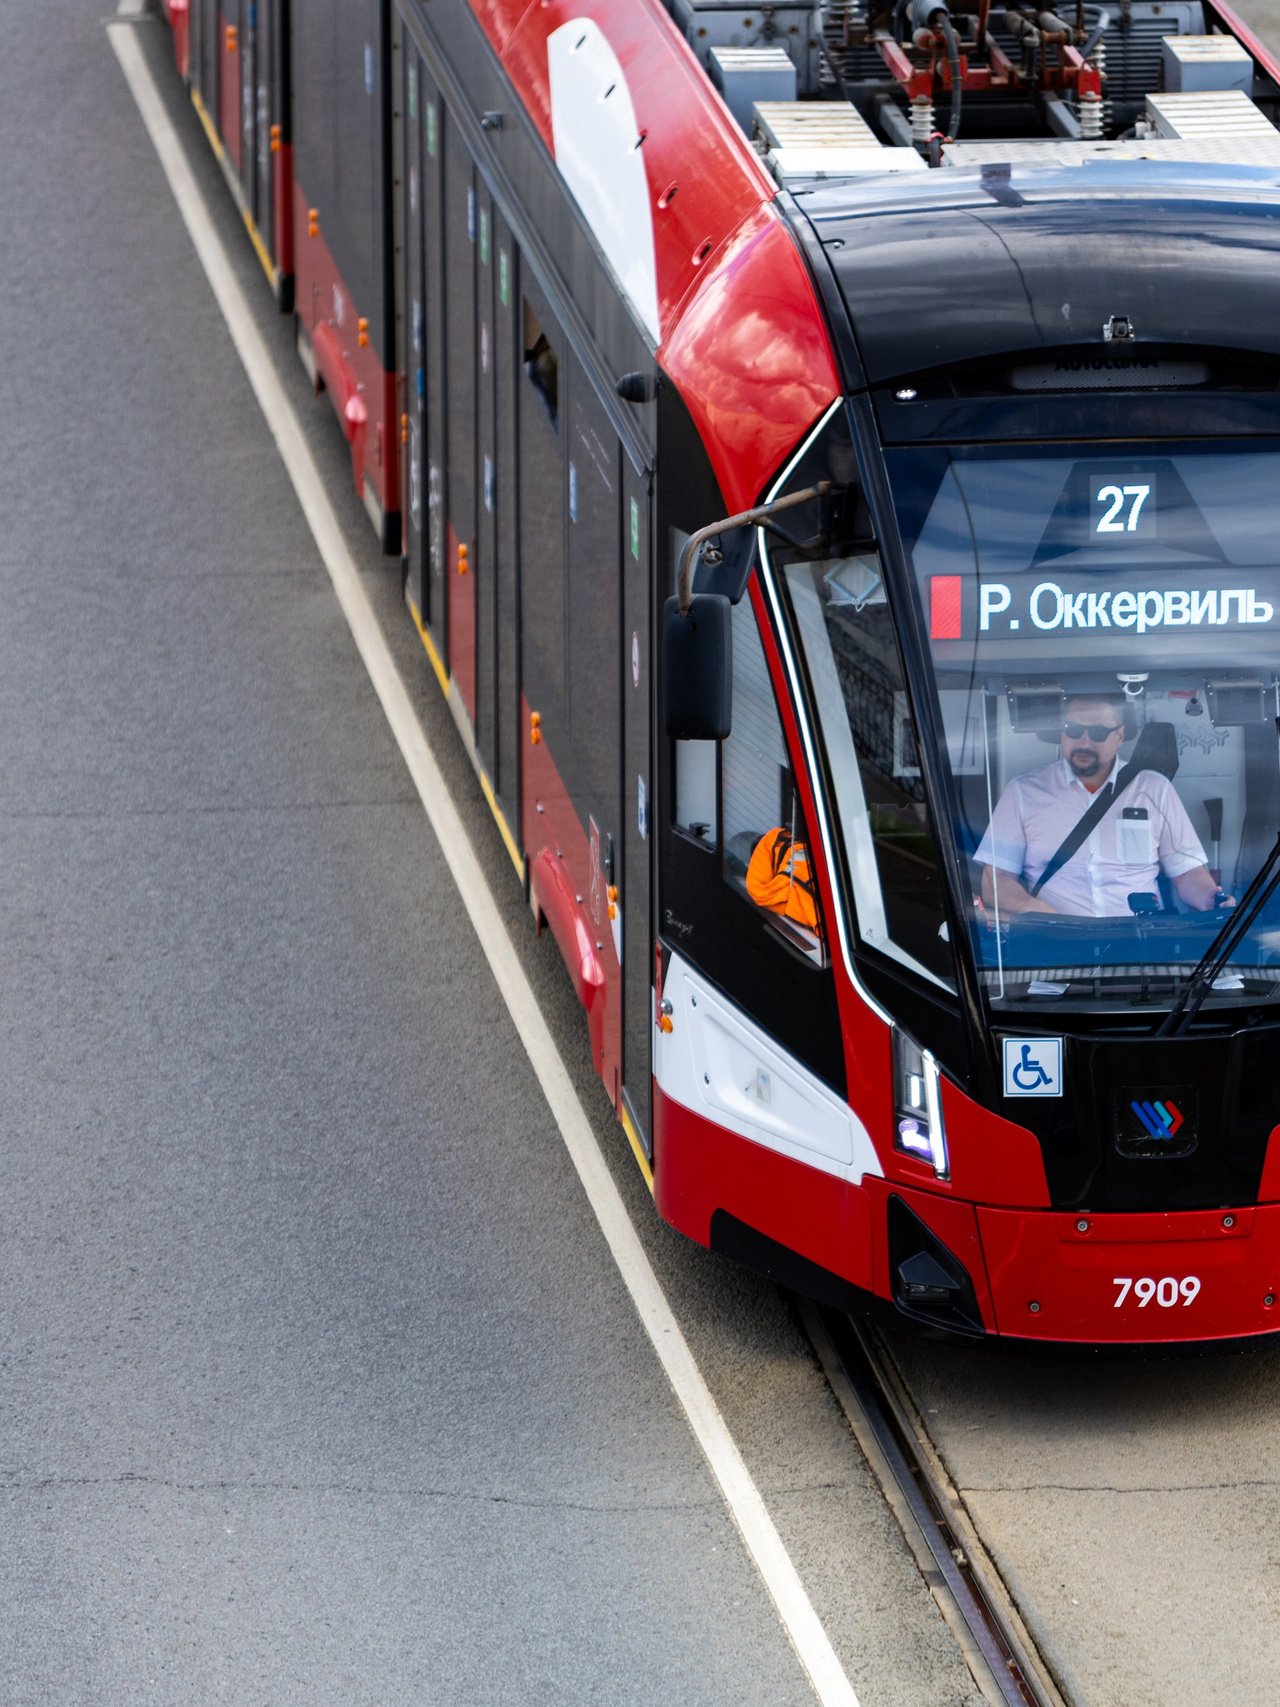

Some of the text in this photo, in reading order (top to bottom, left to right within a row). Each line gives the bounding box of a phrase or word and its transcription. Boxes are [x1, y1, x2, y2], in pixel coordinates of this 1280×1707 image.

[1096, 485, 1150, 533] 27
[980, 582, 1274, 633] Р. Оккервиль
[1113, 1276, 1201, 1308] 7909
